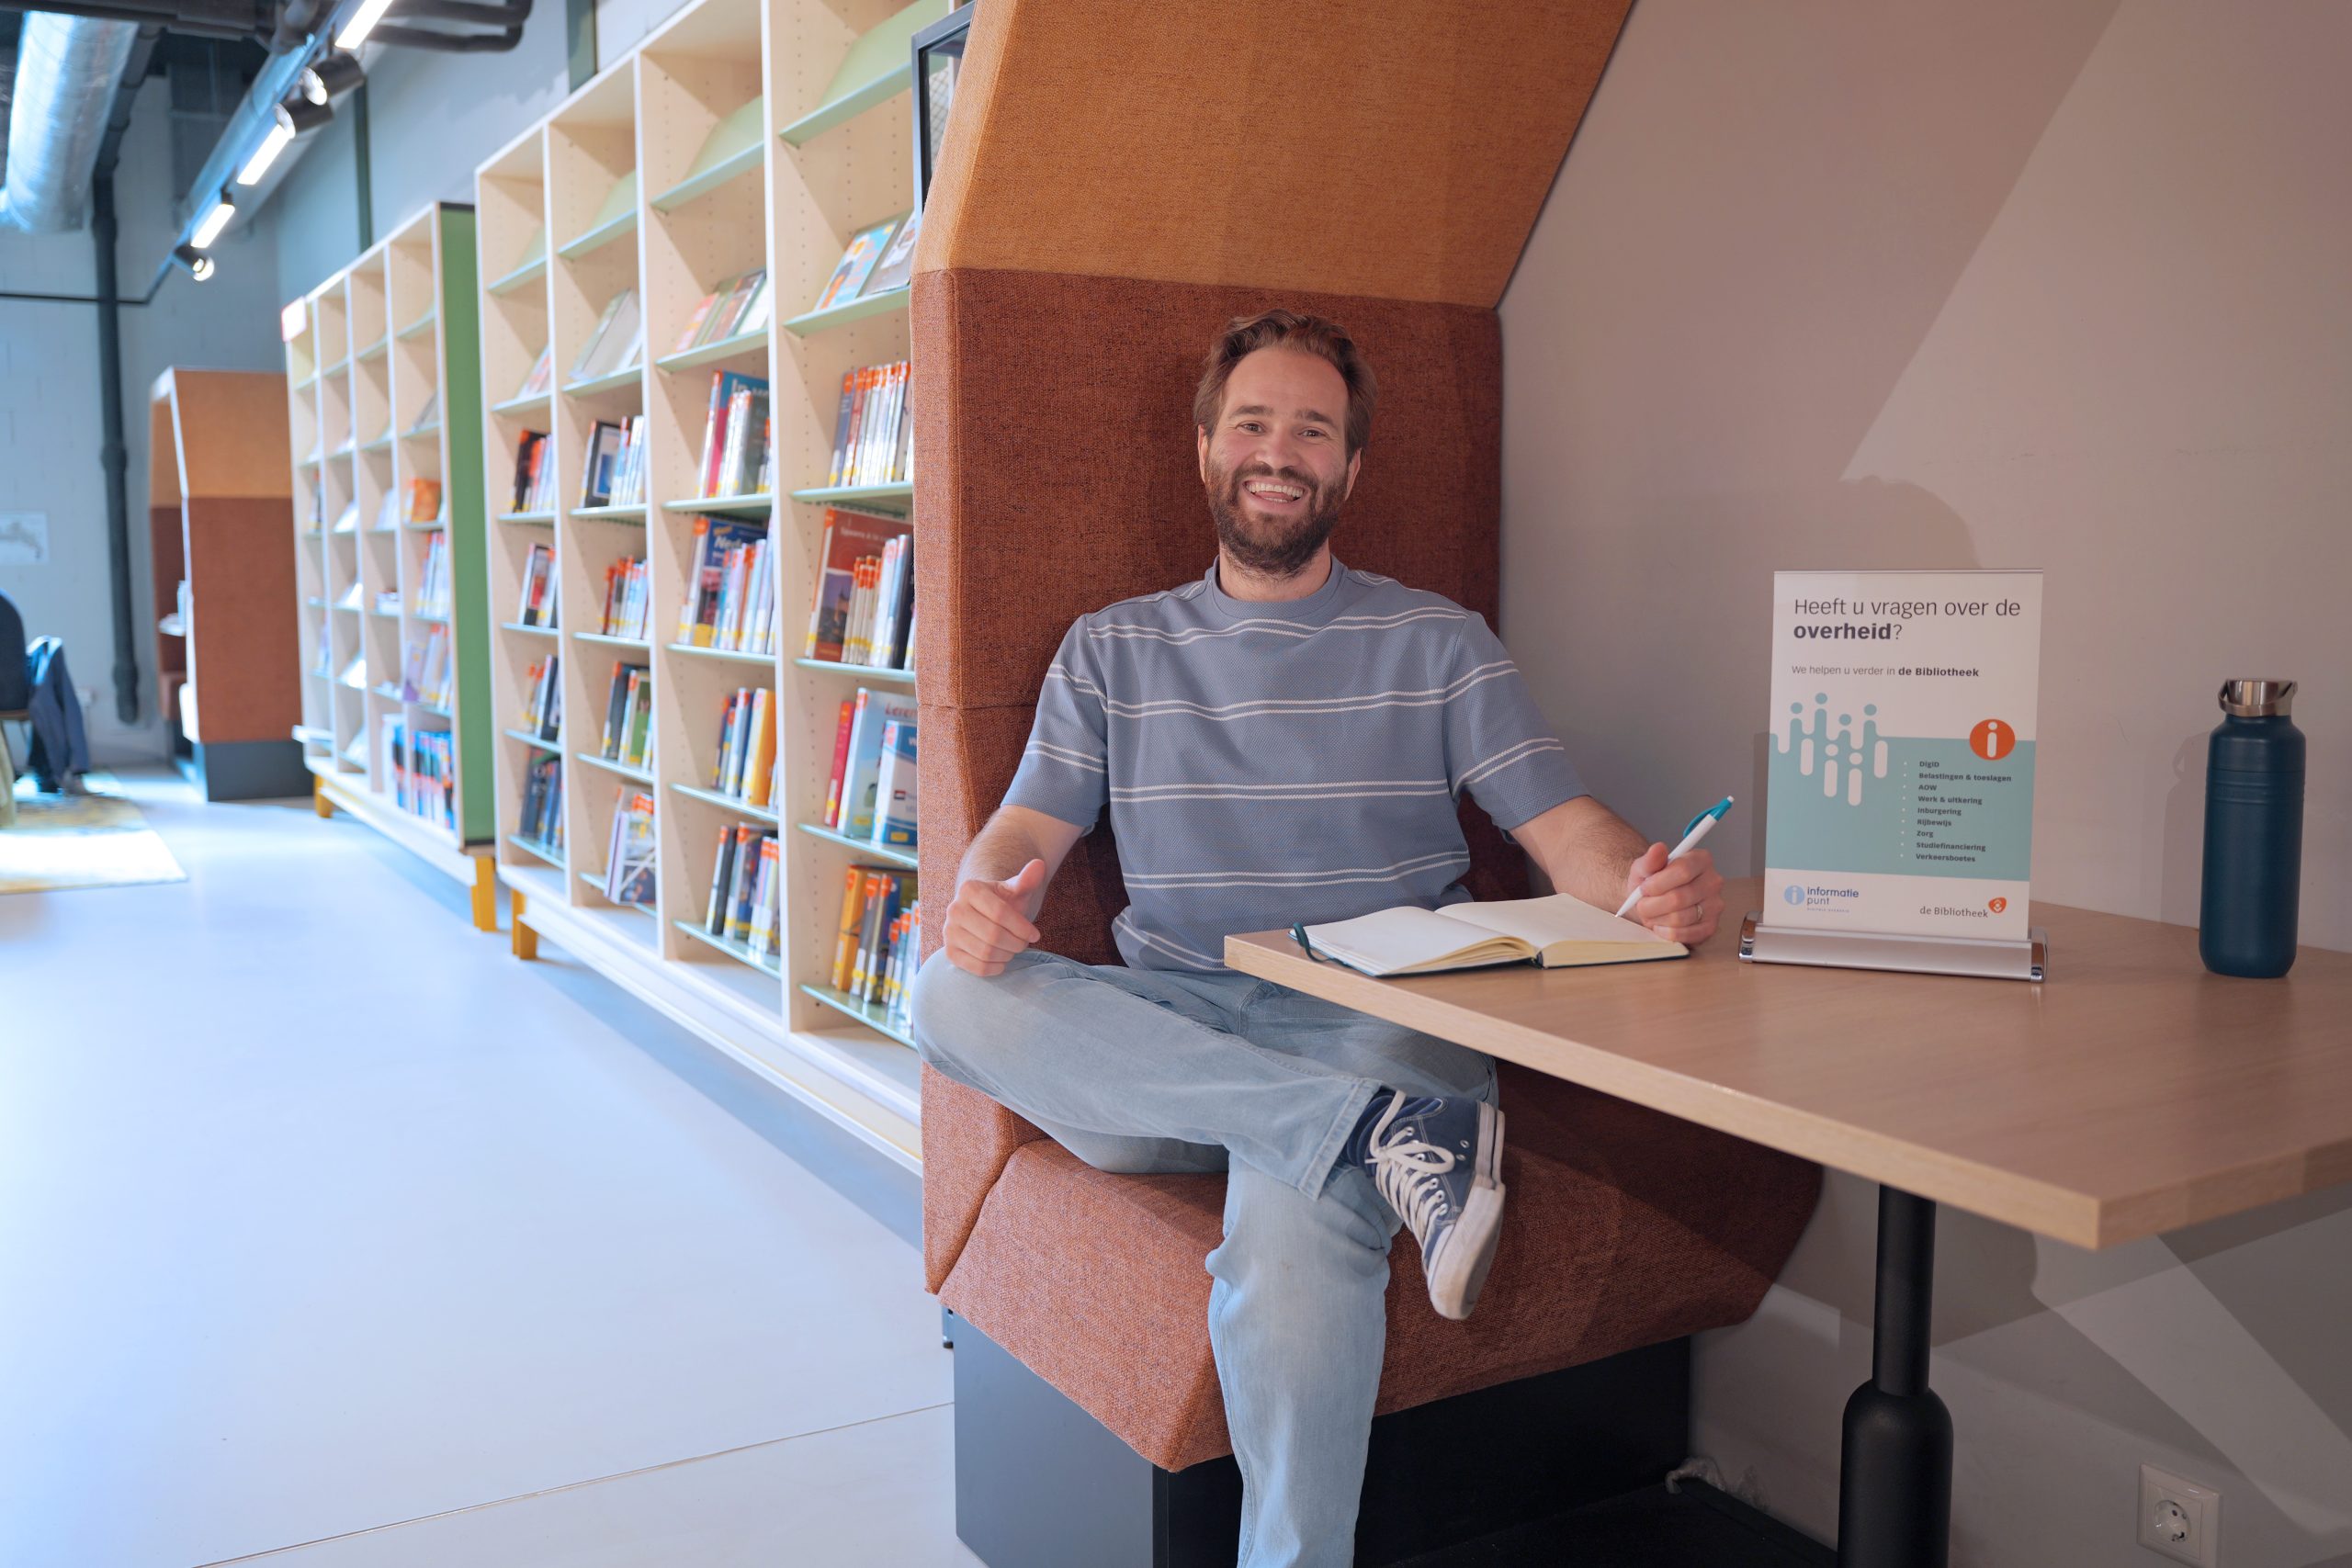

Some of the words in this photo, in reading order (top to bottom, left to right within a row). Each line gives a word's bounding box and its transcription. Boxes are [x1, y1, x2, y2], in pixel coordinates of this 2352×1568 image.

[1794, 598, 1846, 615] Heeft
[1852, 601, 1864, 615] u
[1871, 602, 1937, 619] vragen
[1944, 602, 1989, 616] over
[1996, 599, 2020, 616] de
[1793, 623, 1903, 639] overheid?
[1792, 665, 1806, 674] We
[1809, 665, 1841, 678] helpen
[1853, 667, 1883, 676] verder
[1887, 666, 1895, 676] in
[1898, 667, 1912, 676] de
[1916, 668, 1979, 677] Bibliotheek
[1918, 773, 1963, 781] Belastingen
[1973, 774, 2012, 783] toeslagen
[1948, 796, 1983, 806] uitkering
[1917, 807, 1962, 817] Inburgering
[1917, 842, 1985, 852] Studiefinanciering
[1916, 853, 1975, 862] Verkeersboetes
[1807, 886, 1859, 897] informatie
[1807, 897, 1830, 906] punt
[1919, 906, 1932, 916] de
[1934, 907, 1988, 919] Bibliotheek
